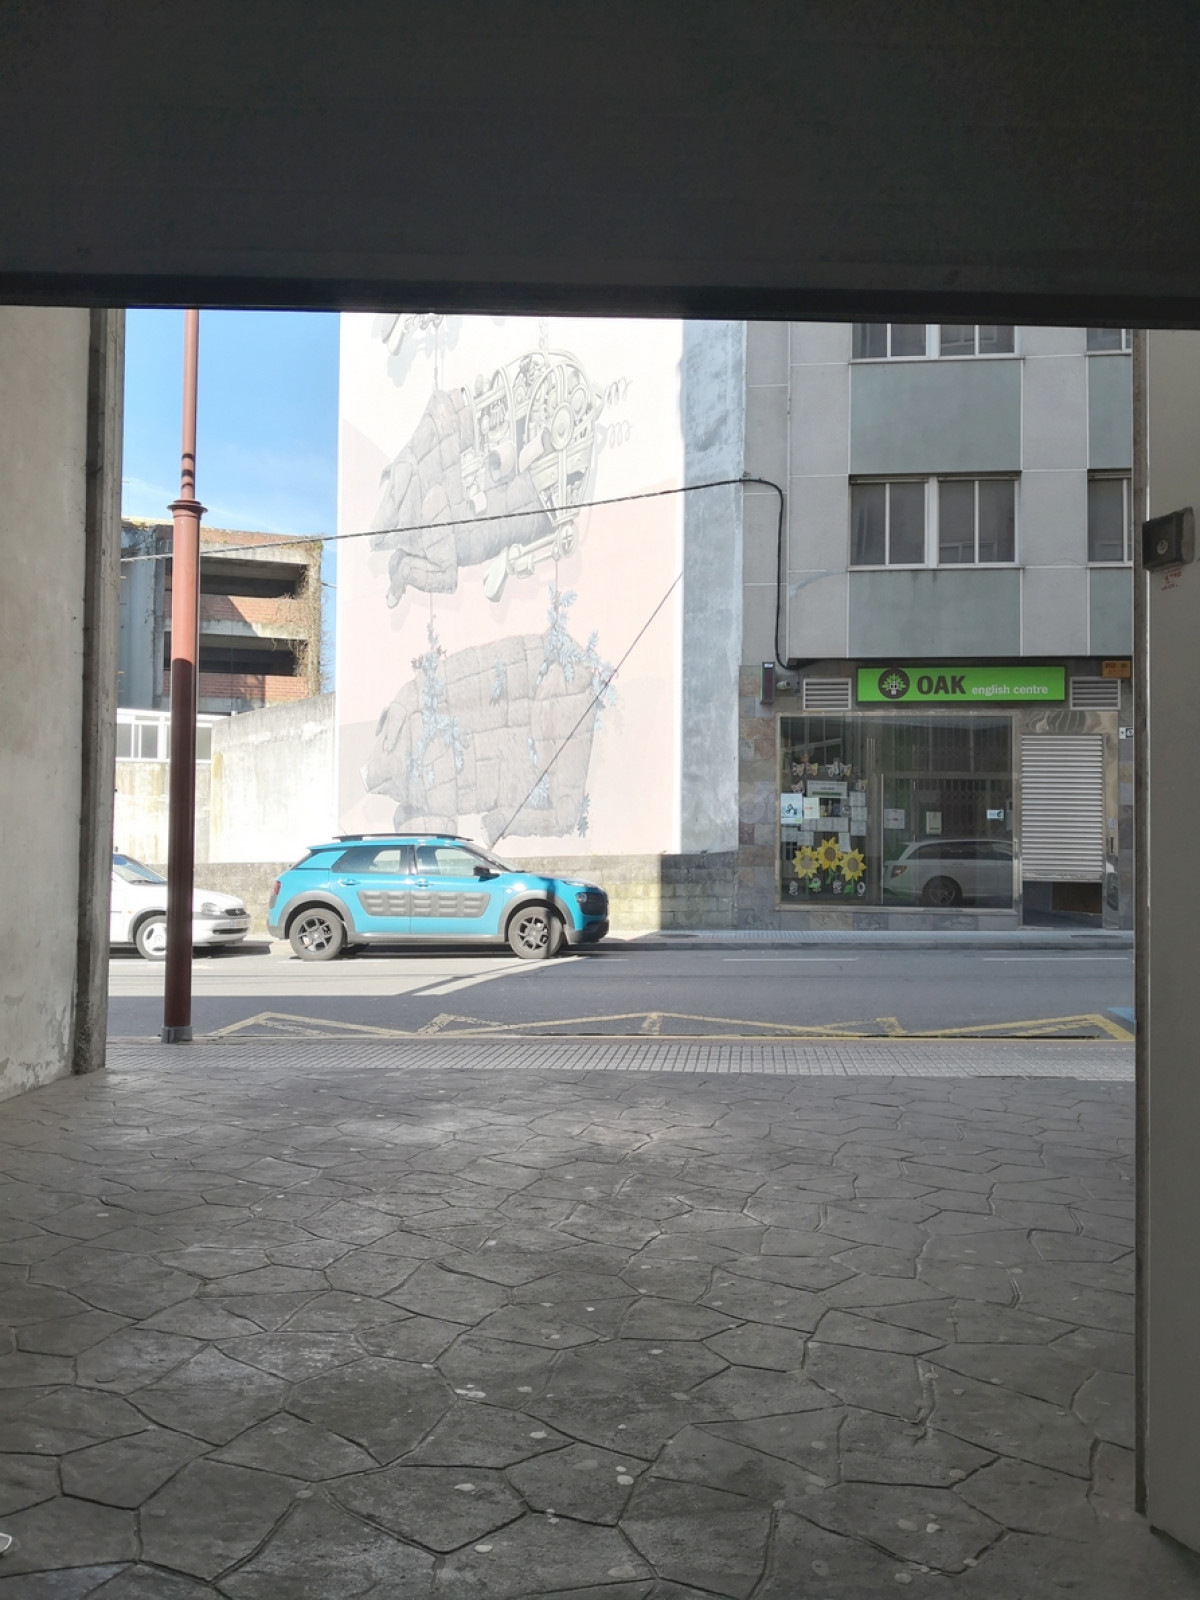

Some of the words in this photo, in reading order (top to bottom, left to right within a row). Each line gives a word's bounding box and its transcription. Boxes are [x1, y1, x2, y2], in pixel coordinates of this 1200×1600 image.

[917, 675, 966, 695] OAK
[972, 684, 1010, 697] english
[1013, 685, 1048, 695] centre
